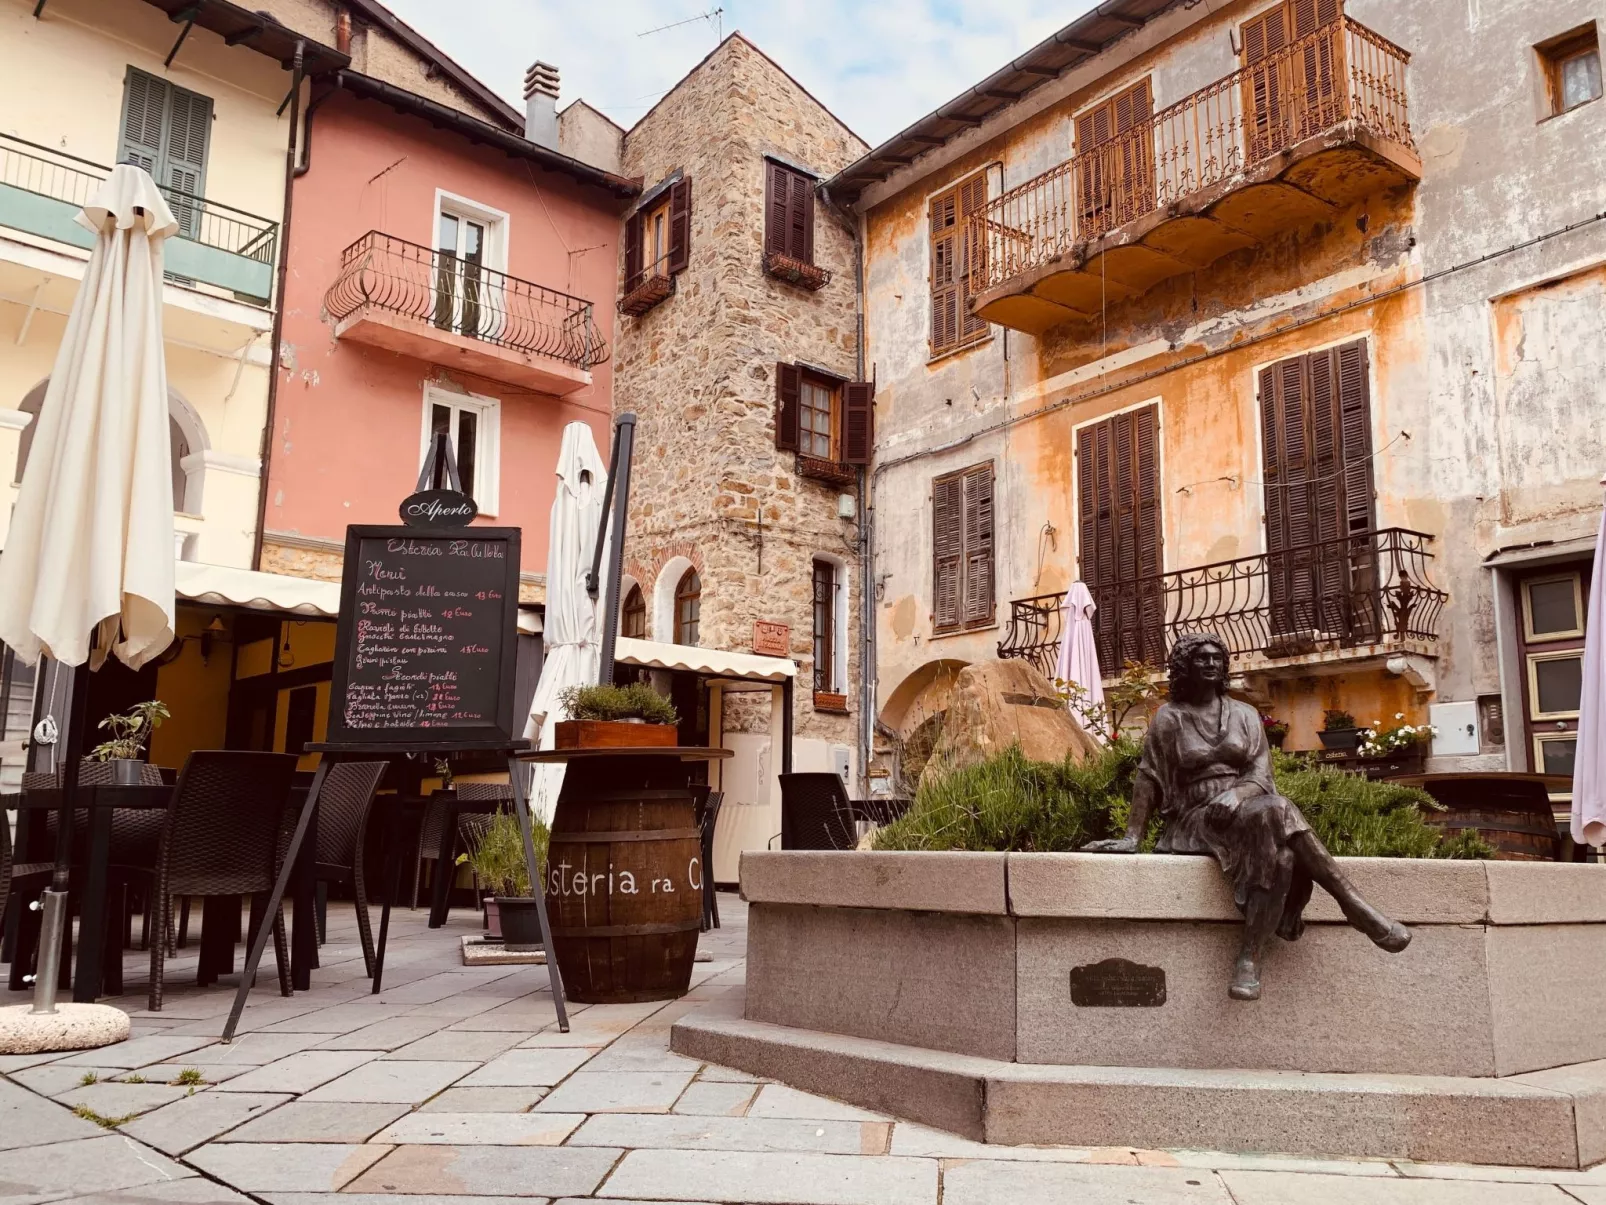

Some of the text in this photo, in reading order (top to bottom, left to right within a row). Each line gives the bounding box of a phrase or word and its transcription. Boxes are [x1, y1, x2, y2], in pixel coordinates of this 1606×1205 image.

[408, 498, 473, 522] Aperto
[357, 582, 411, 600] Antipasto
[415, 585, 441, 597] della
[401, 608, 432, 622] piatti
[455, 606, 473, 617] Euro
[358, 620, 395, 634] Ravioli
[428, 670, 457, 684] piatti
[442, 682, 457, 690] Euro
[444, 691, 461, 701] Euro
[438, 701, 456, 710] Euro
[463, 711, 482, 719] Euro
[431, 719, 449, 727] Euro
[651, 878, 675, 894] ra
